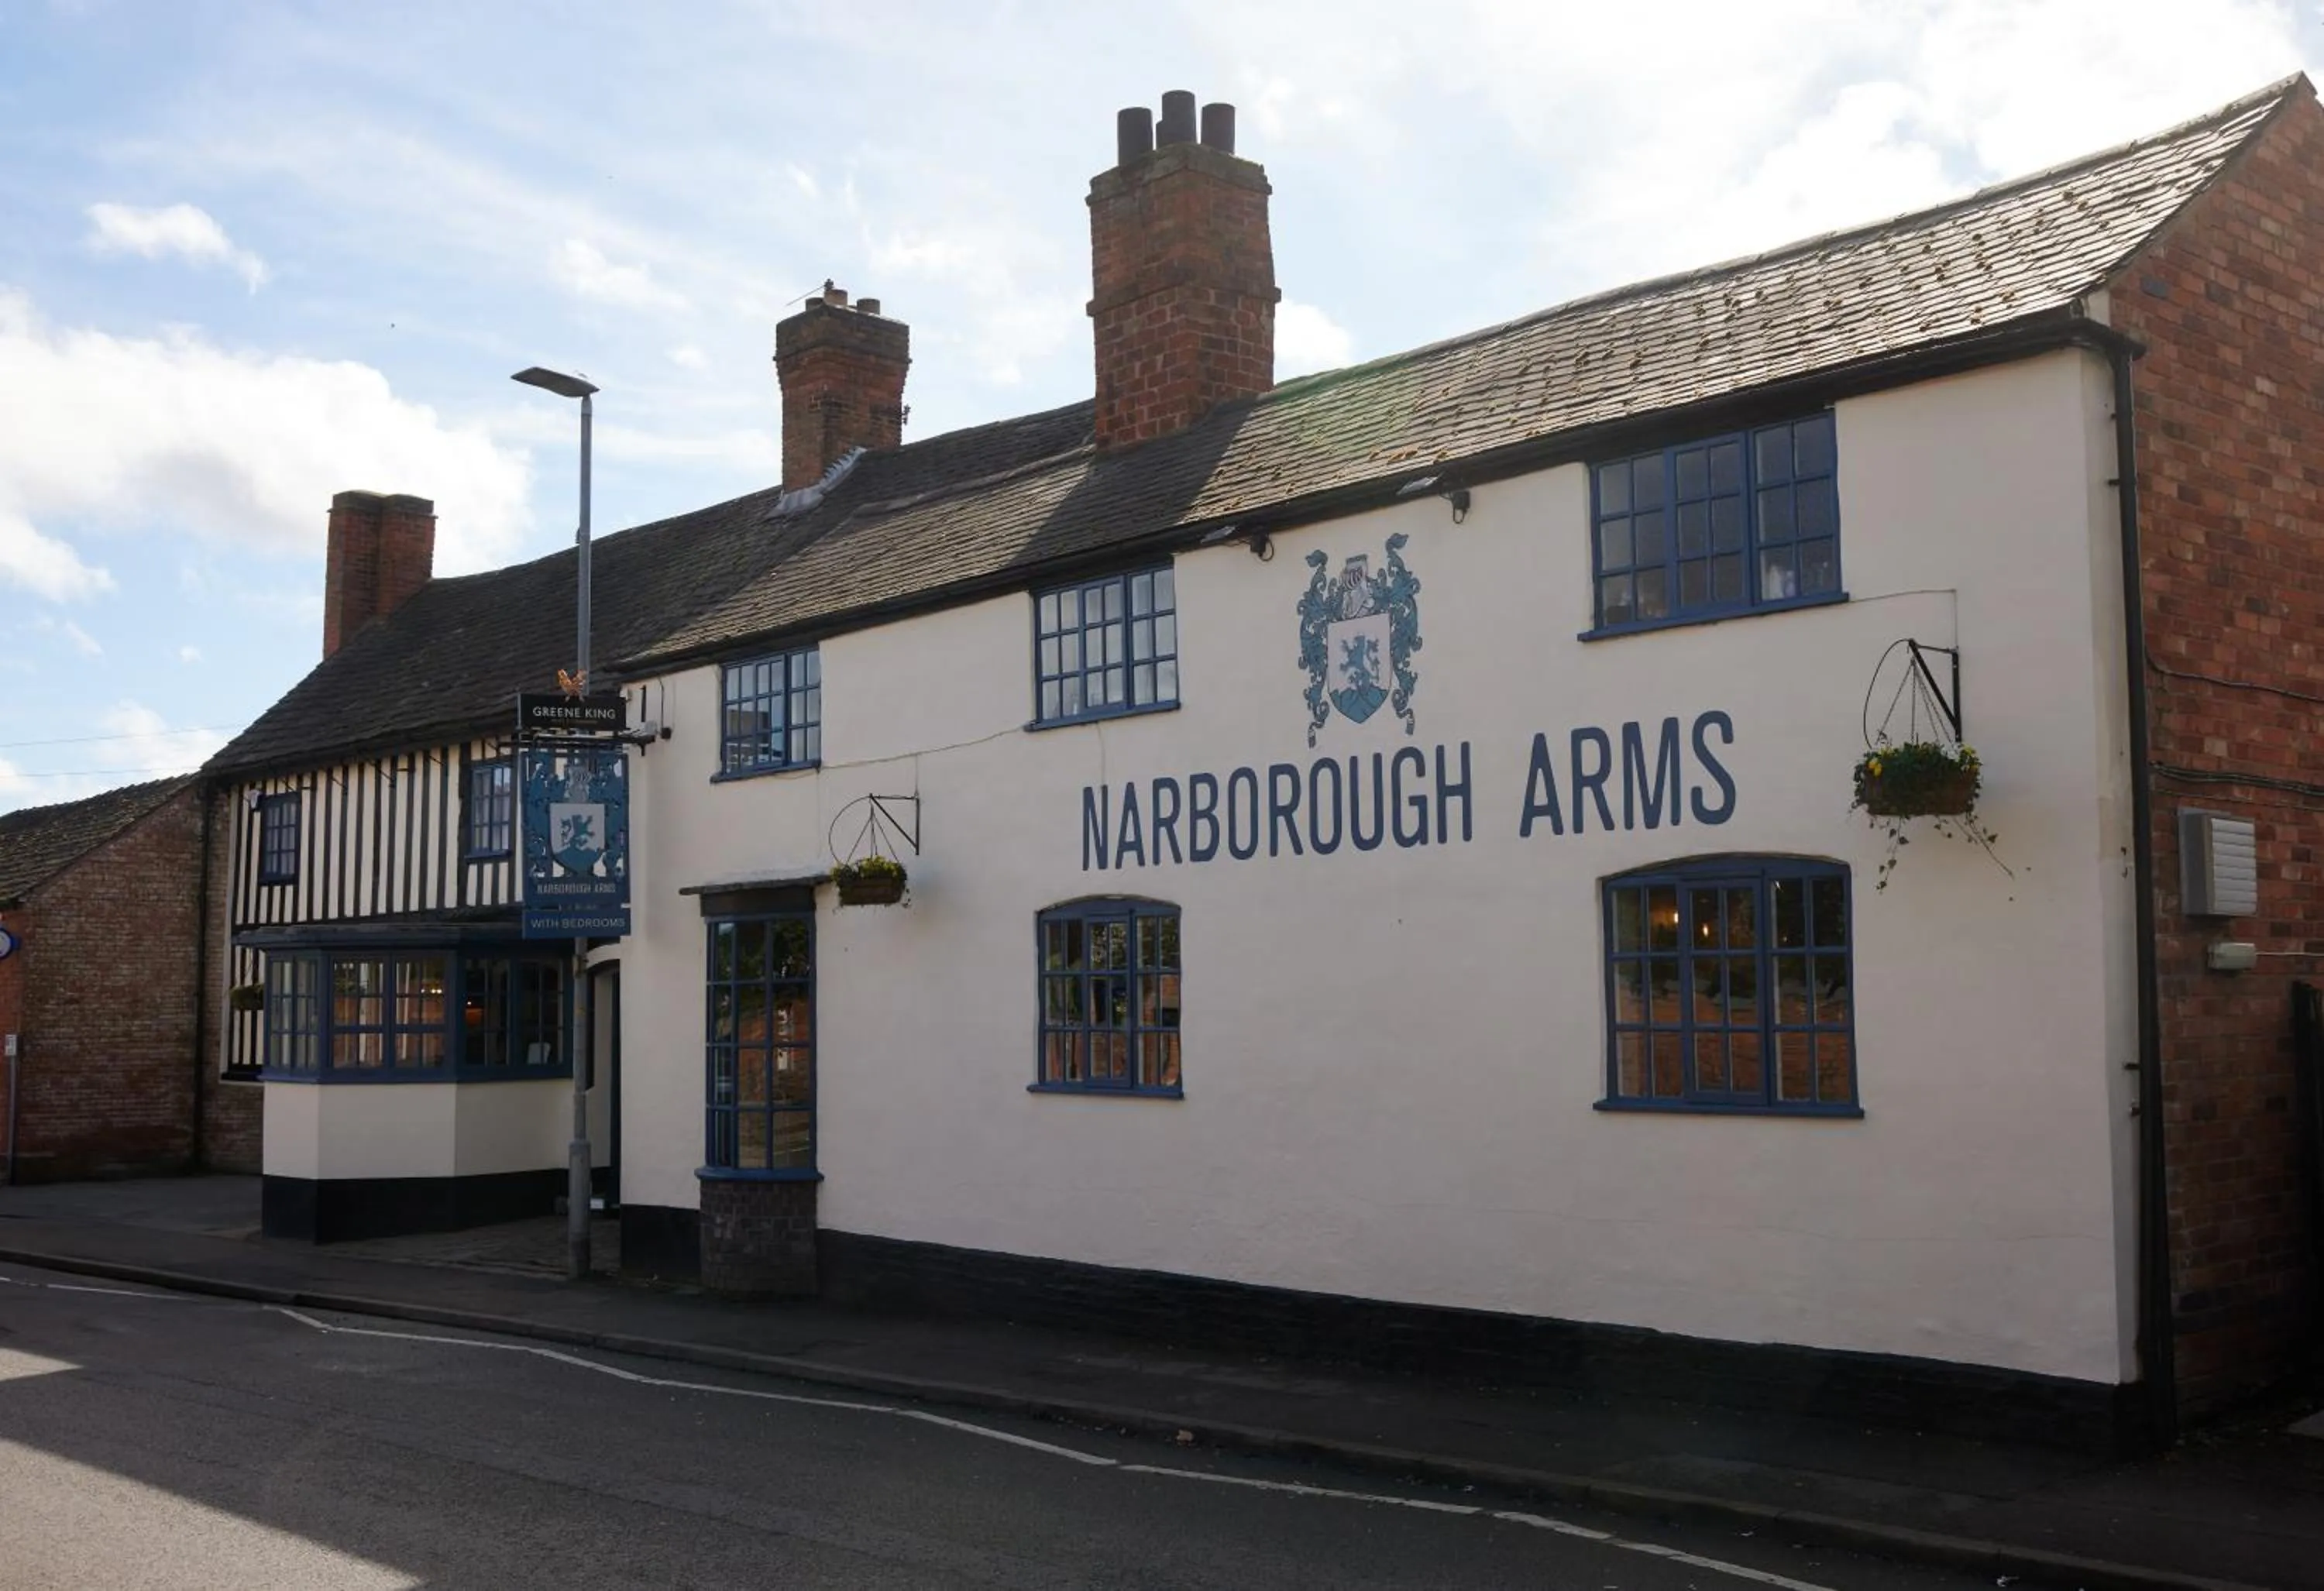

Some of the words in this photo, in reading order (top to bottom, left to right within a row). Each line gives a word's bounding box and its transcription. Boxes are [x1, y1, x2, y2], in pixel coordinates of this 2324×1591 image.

[532, 706, 582, 718] GREENE
[585, 707, 617, 720] KING
[1082, 741, 1473, 871] NARBOROUGH
[1519, 710, 1737, 837] ARMS
[530, 918, 559, 929] WITH
[562, 917, 625, 929] BEDROOMS
